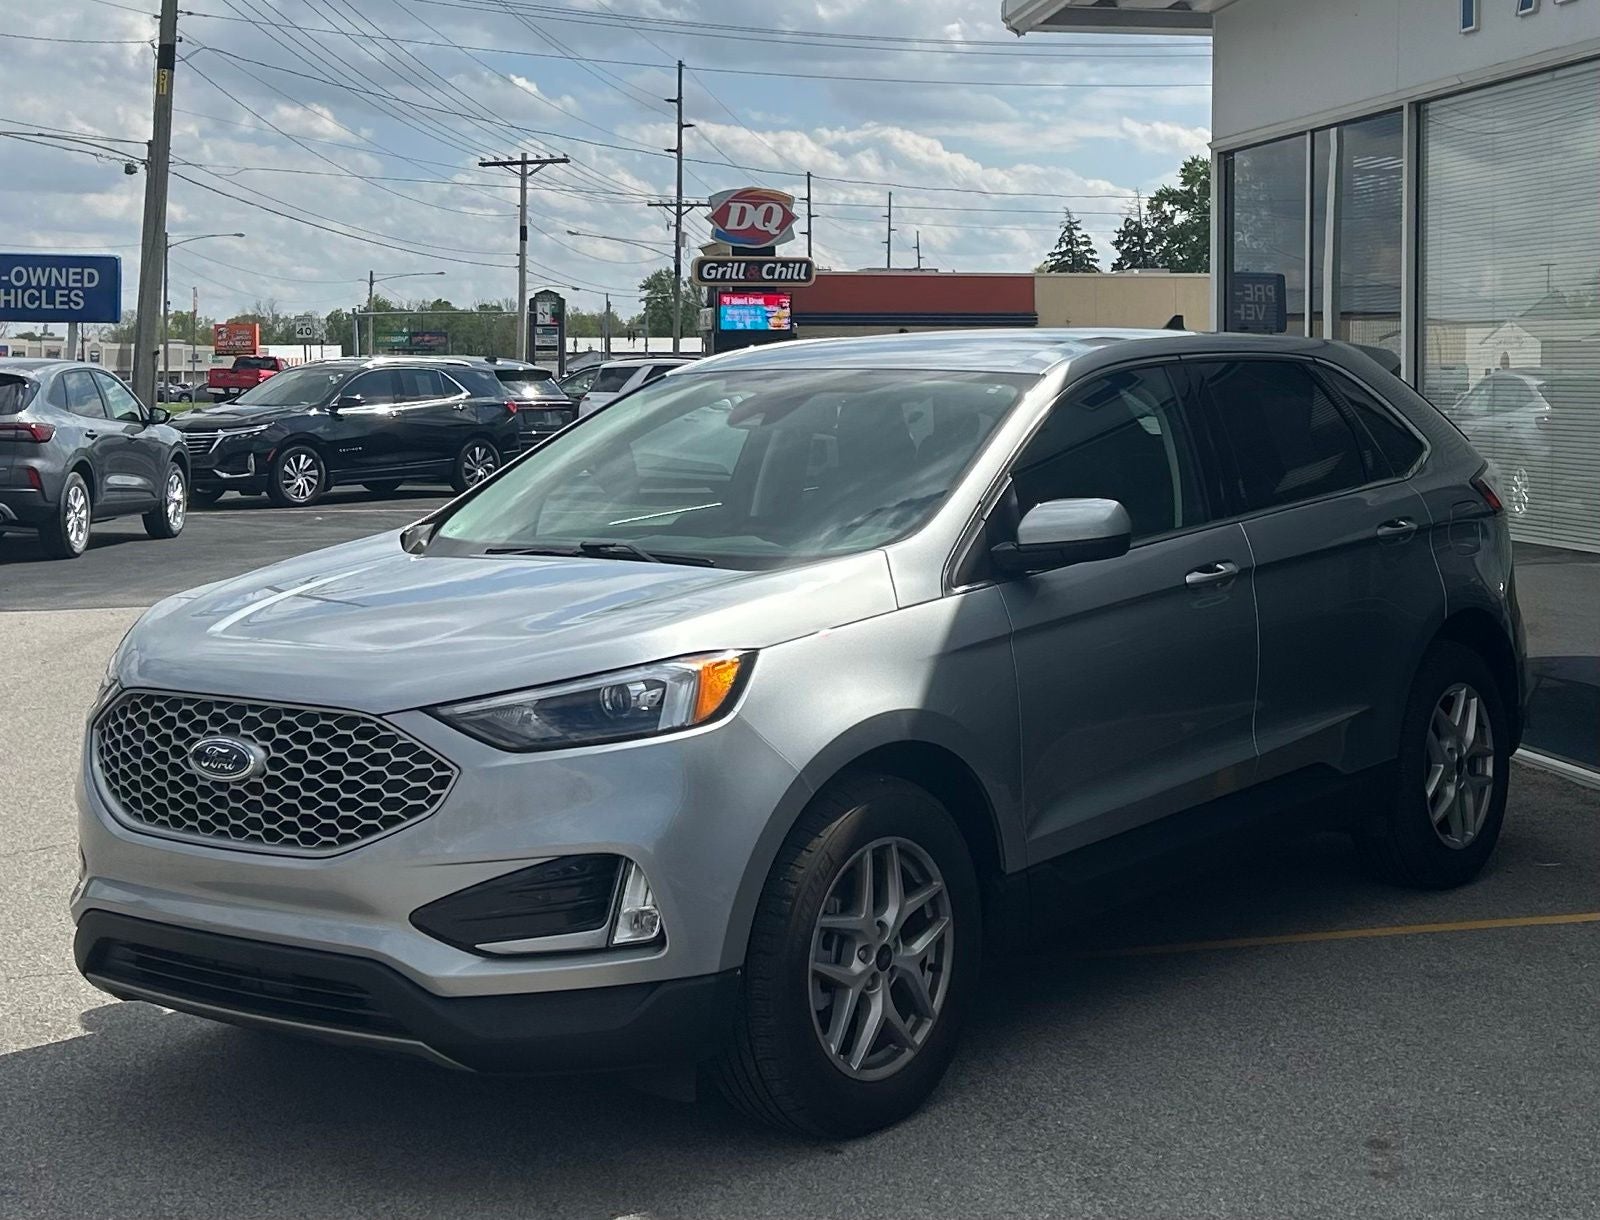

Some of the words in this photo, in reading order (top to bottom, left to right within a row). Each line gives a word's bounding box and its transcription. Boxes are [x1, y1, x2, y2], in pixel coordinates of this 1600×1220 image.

[725, 202, 784, 235] DQ
[702, 262, 746, 280] Grill
[748, 265, 760, 280] &
[761, 262, 807, 280] Chill
[297, 327, 312, 336] 40
[201, 745, 238, 771] Ford
